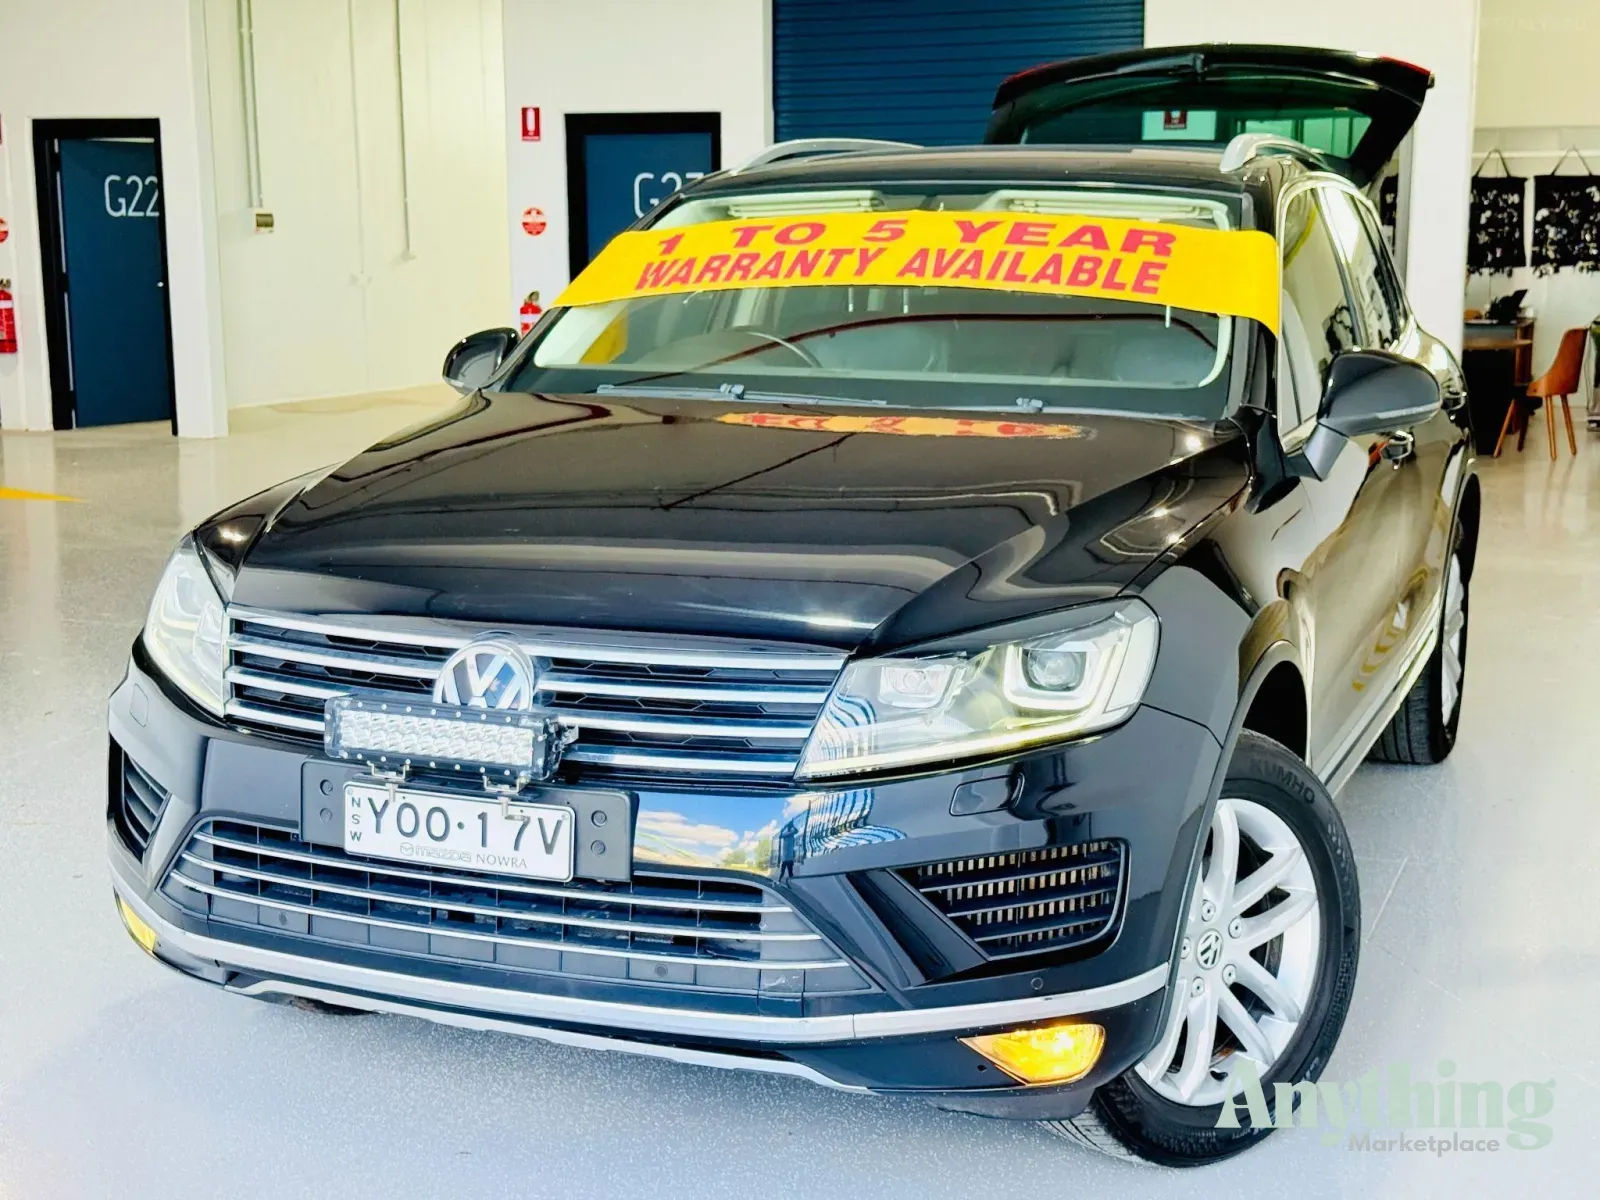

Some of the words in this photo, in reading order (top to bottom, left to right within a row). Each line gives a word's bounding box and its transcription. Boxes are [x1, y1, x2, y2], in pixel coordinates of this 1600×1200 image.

[104, 175, 160, 217] G22
[633, 171, 704, 219] G2
[659, 233, 685, 256] 1
[731, 222, 827, 249] TO
[862, 219, 909, 243] 5
[954, 220, 1177, 257] YEAR
[635, 247, 887, 290] WARRANTY
[896, 248, 1167, 295] AVAILABLE
[475, 853, 528, 869] NOWRA
